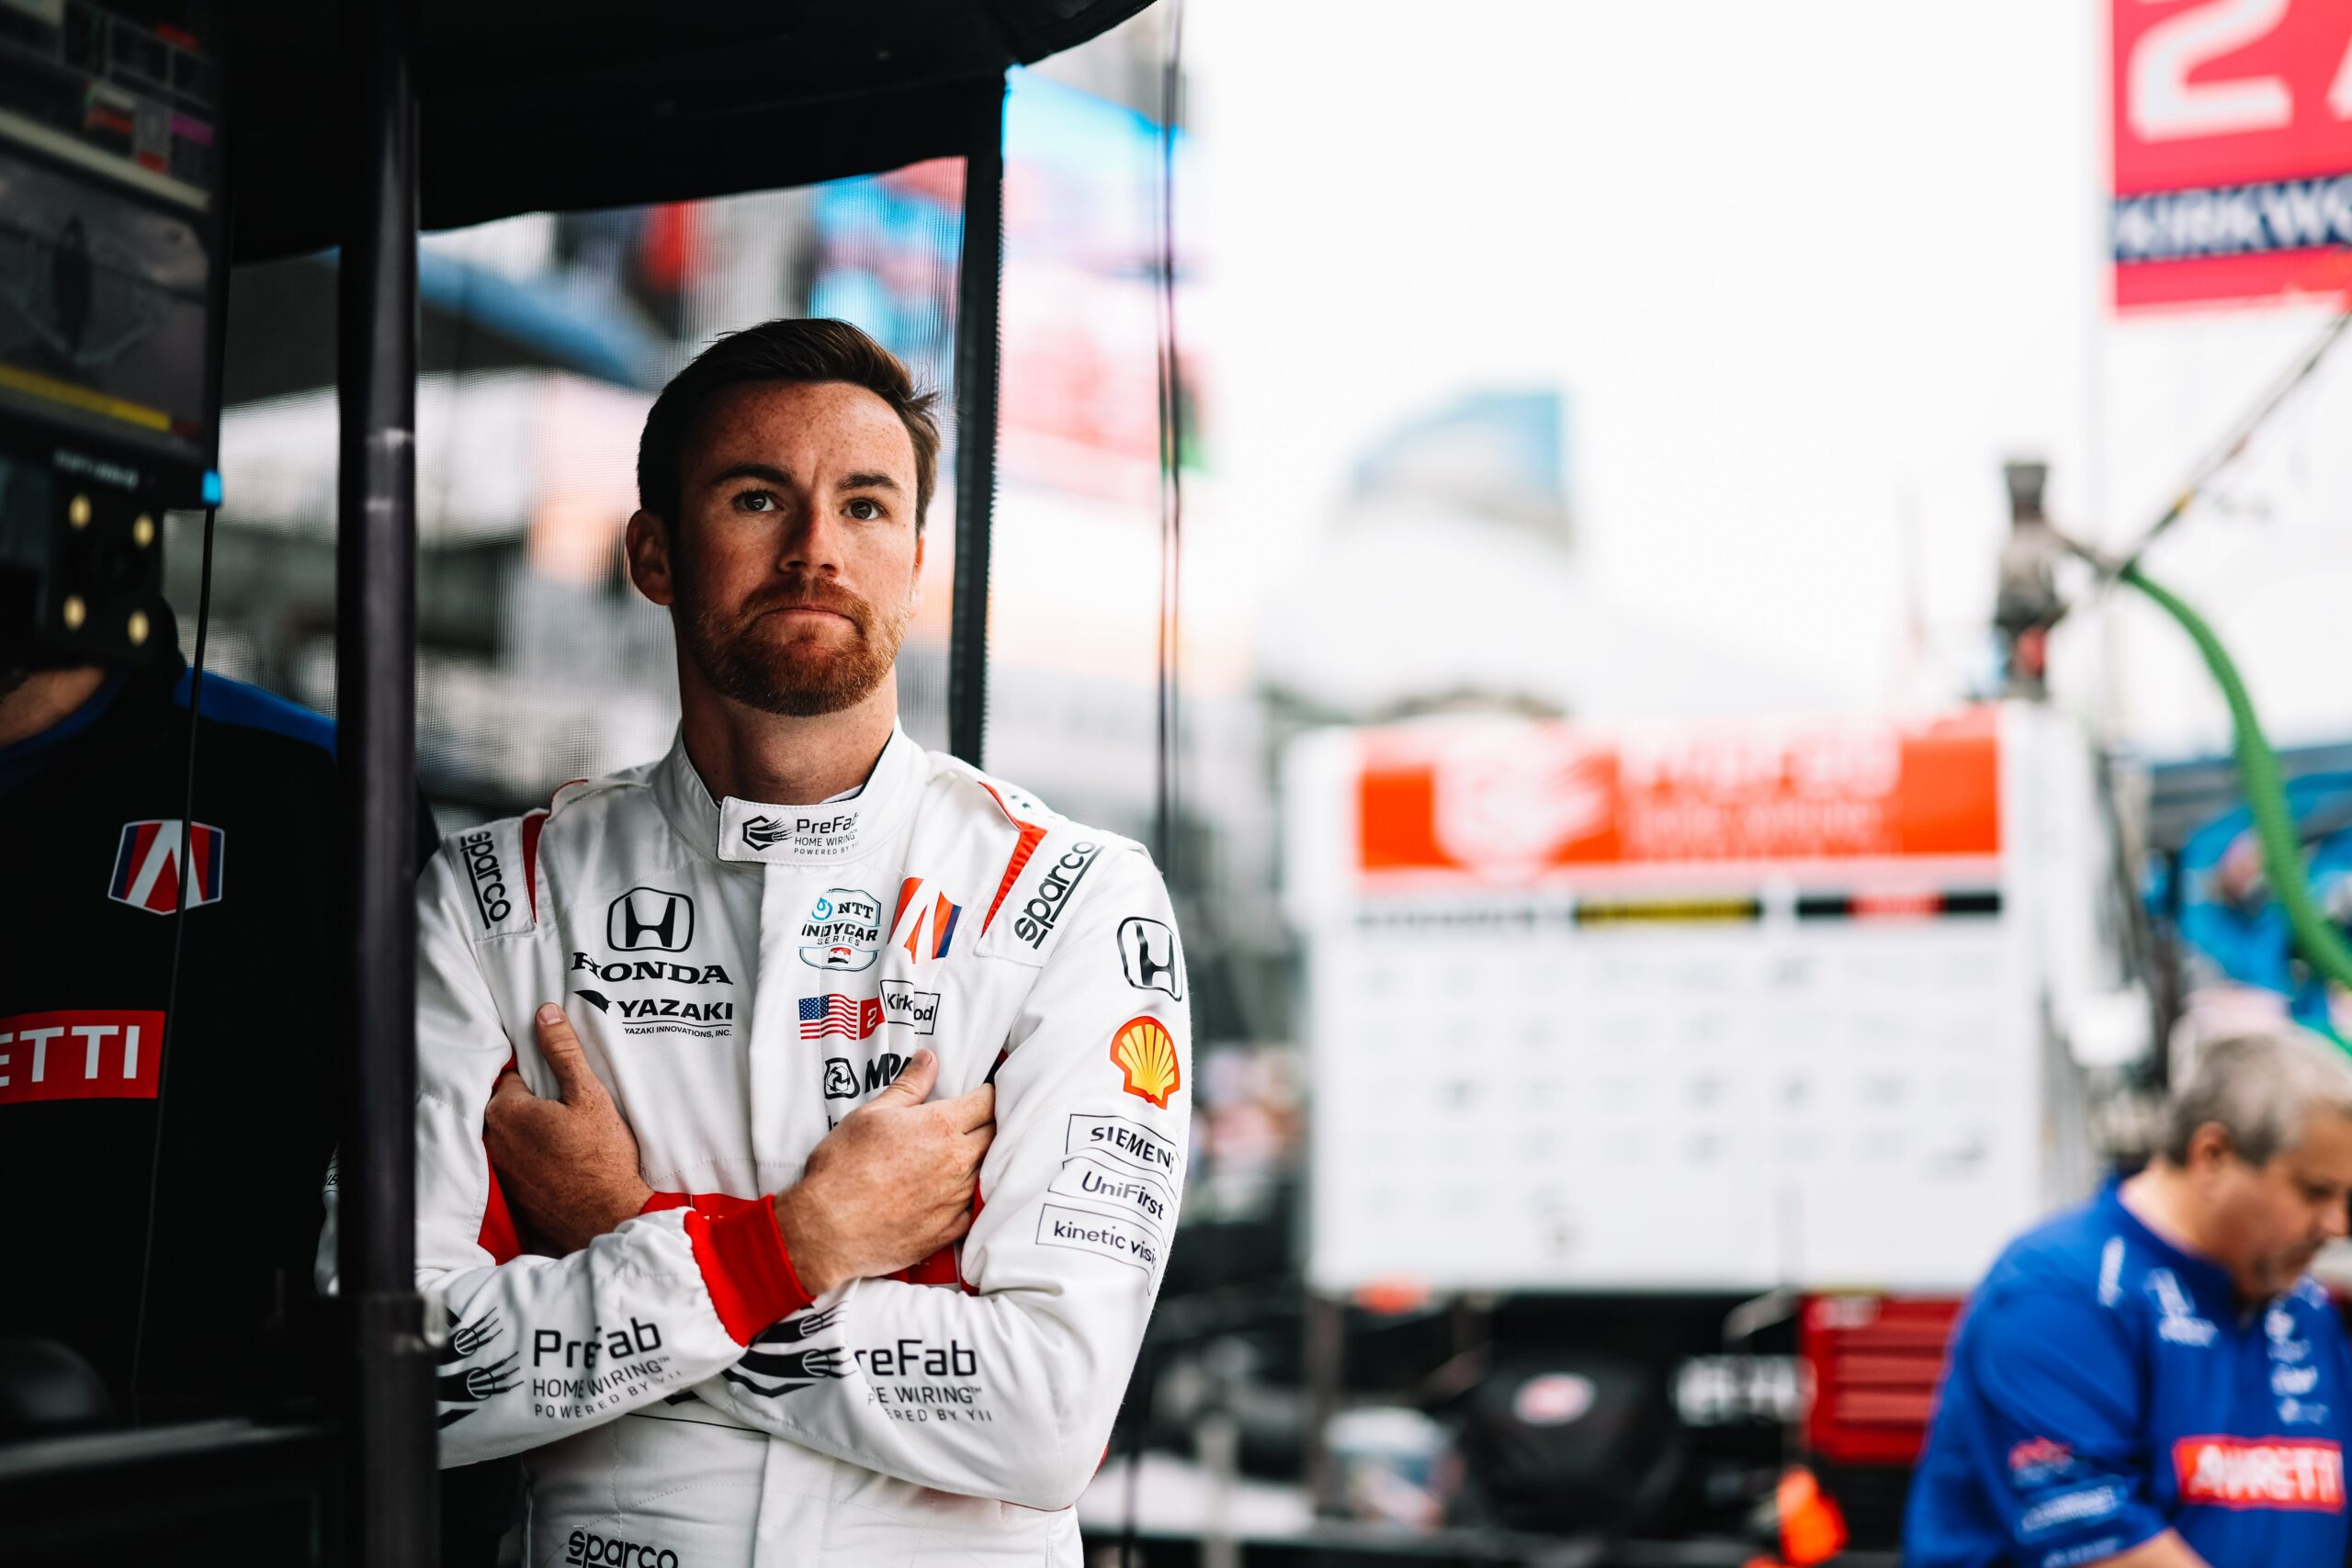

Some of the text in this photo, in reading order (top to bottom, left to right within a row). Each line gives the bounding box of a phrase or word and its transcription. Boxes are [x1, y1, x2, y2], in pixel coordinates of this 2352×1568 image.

[2124, 0, 2352, 142] 2
[795, 837, 822, 846] HOME
[460, 830, 511, 924] sparco
[1014, 841, 1098, 944] sparco
[838, 902, 873, 919] NTT
[801, 923, 878, 941] INDYCAR
[817, 935, 860, 946] SERIES
[571, 952, 733, 986] HONDA
[617, 999, 733, 1021] YAZAKI
[866, 1007, 877, 1029] 2
[888, 993, 934, 1021] Kirkod
[625, 1025, 732, 1038] YAZAKI INNOVATIONS, INC.
[1081, 1171, 1164, 1220] UniFirst
[1054, 1221, 1157, 1269] kinetic visi
[534, 1316, 662, 1369] Preab
[854, 1339, 977, 1376] reFab
[533, 1378, 584, 1398] HOME
[535, 1392, 620, 1418] POWERED
[627, 1381, 649, 1396] BY
[937, 1409, 957, 1420] BY
[566, 1530, 679, 1568] sparco
